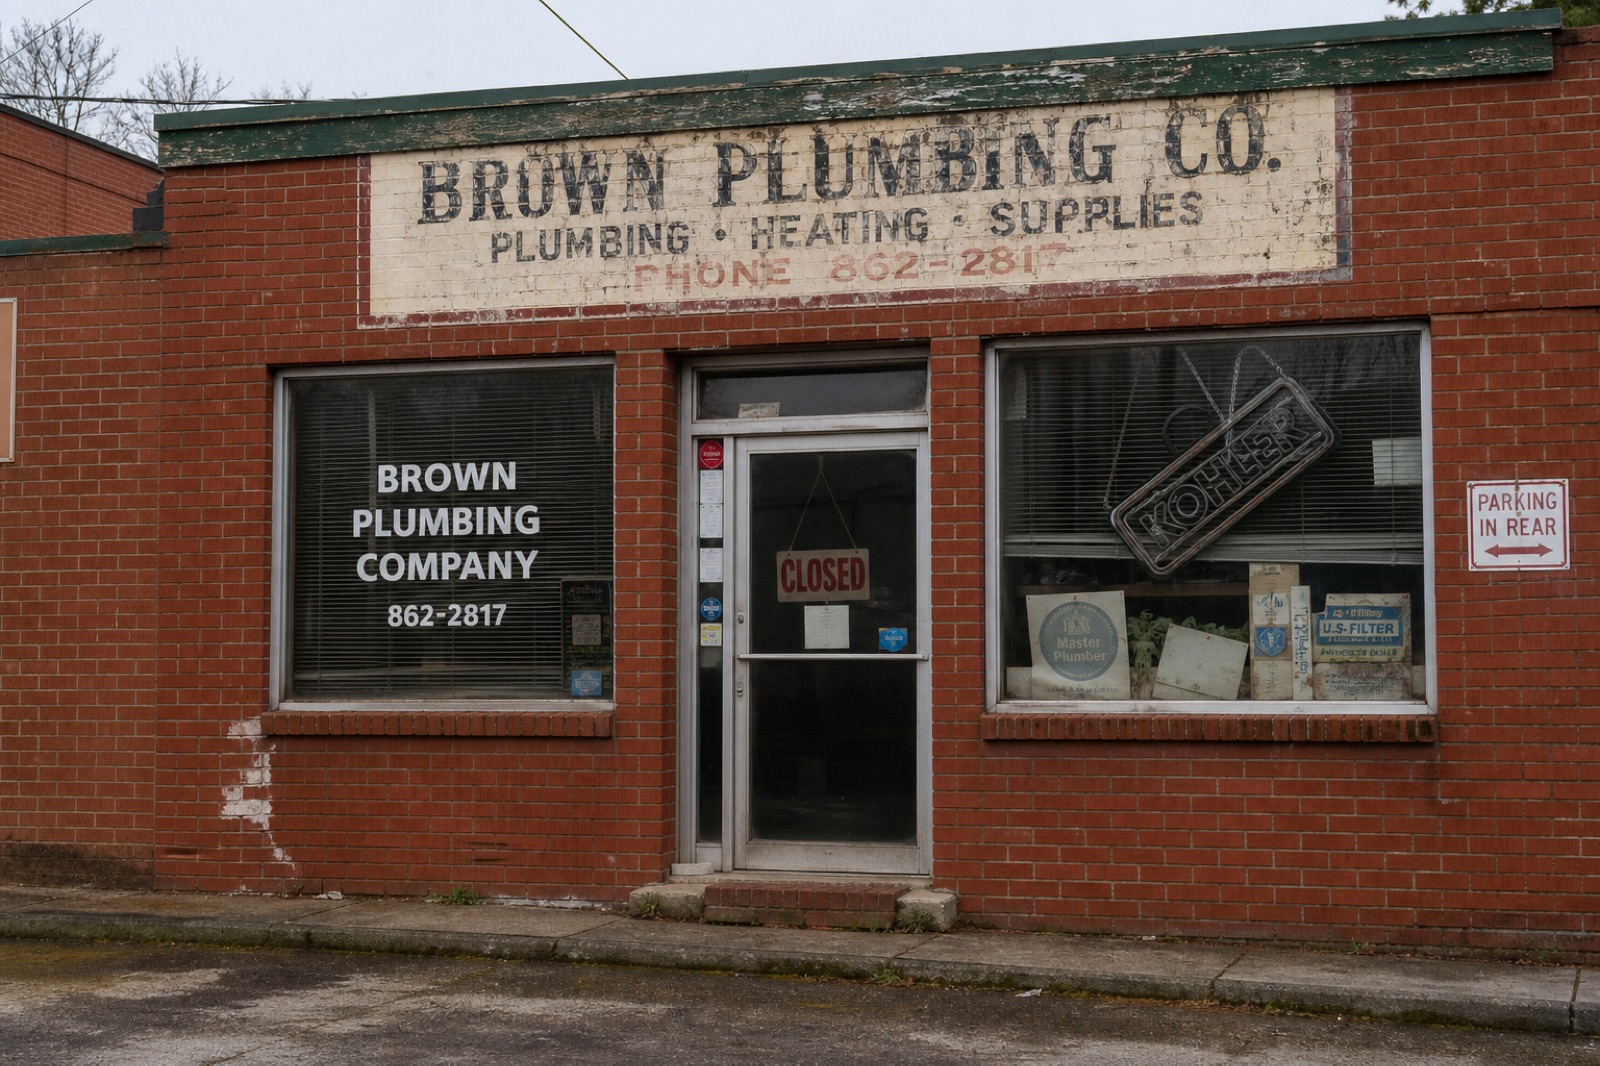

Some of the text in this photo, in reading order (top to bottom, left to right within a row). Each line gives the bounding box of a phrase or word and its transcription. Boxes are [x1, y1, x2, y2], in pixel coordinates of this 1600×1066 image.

[416, 104, 1282, 225] BROWN PLUMBING CO.
[490, 190, 1204, 264] PLUMBING HEATING SUPPLIES
[634, 242, 1068, 292] PHONE 862-2817
[377, 461, 517, 493] BROWN
[1139, 407, 1310, 549] KOHLER
[1478, 491, 1557, 512] PARKING
[352, 505, 541, 538] PLUMBING
[1480, 517, 1557, 537] IN REAR
[356, 550, 540, 582] COMPANY
[780, 556, 867, 593] CLOSED
[387, 603, 507, 628] 862-2817
[1053, 650, 1106, 662] Plumber
[1057, 636, 1102, 649] Master
